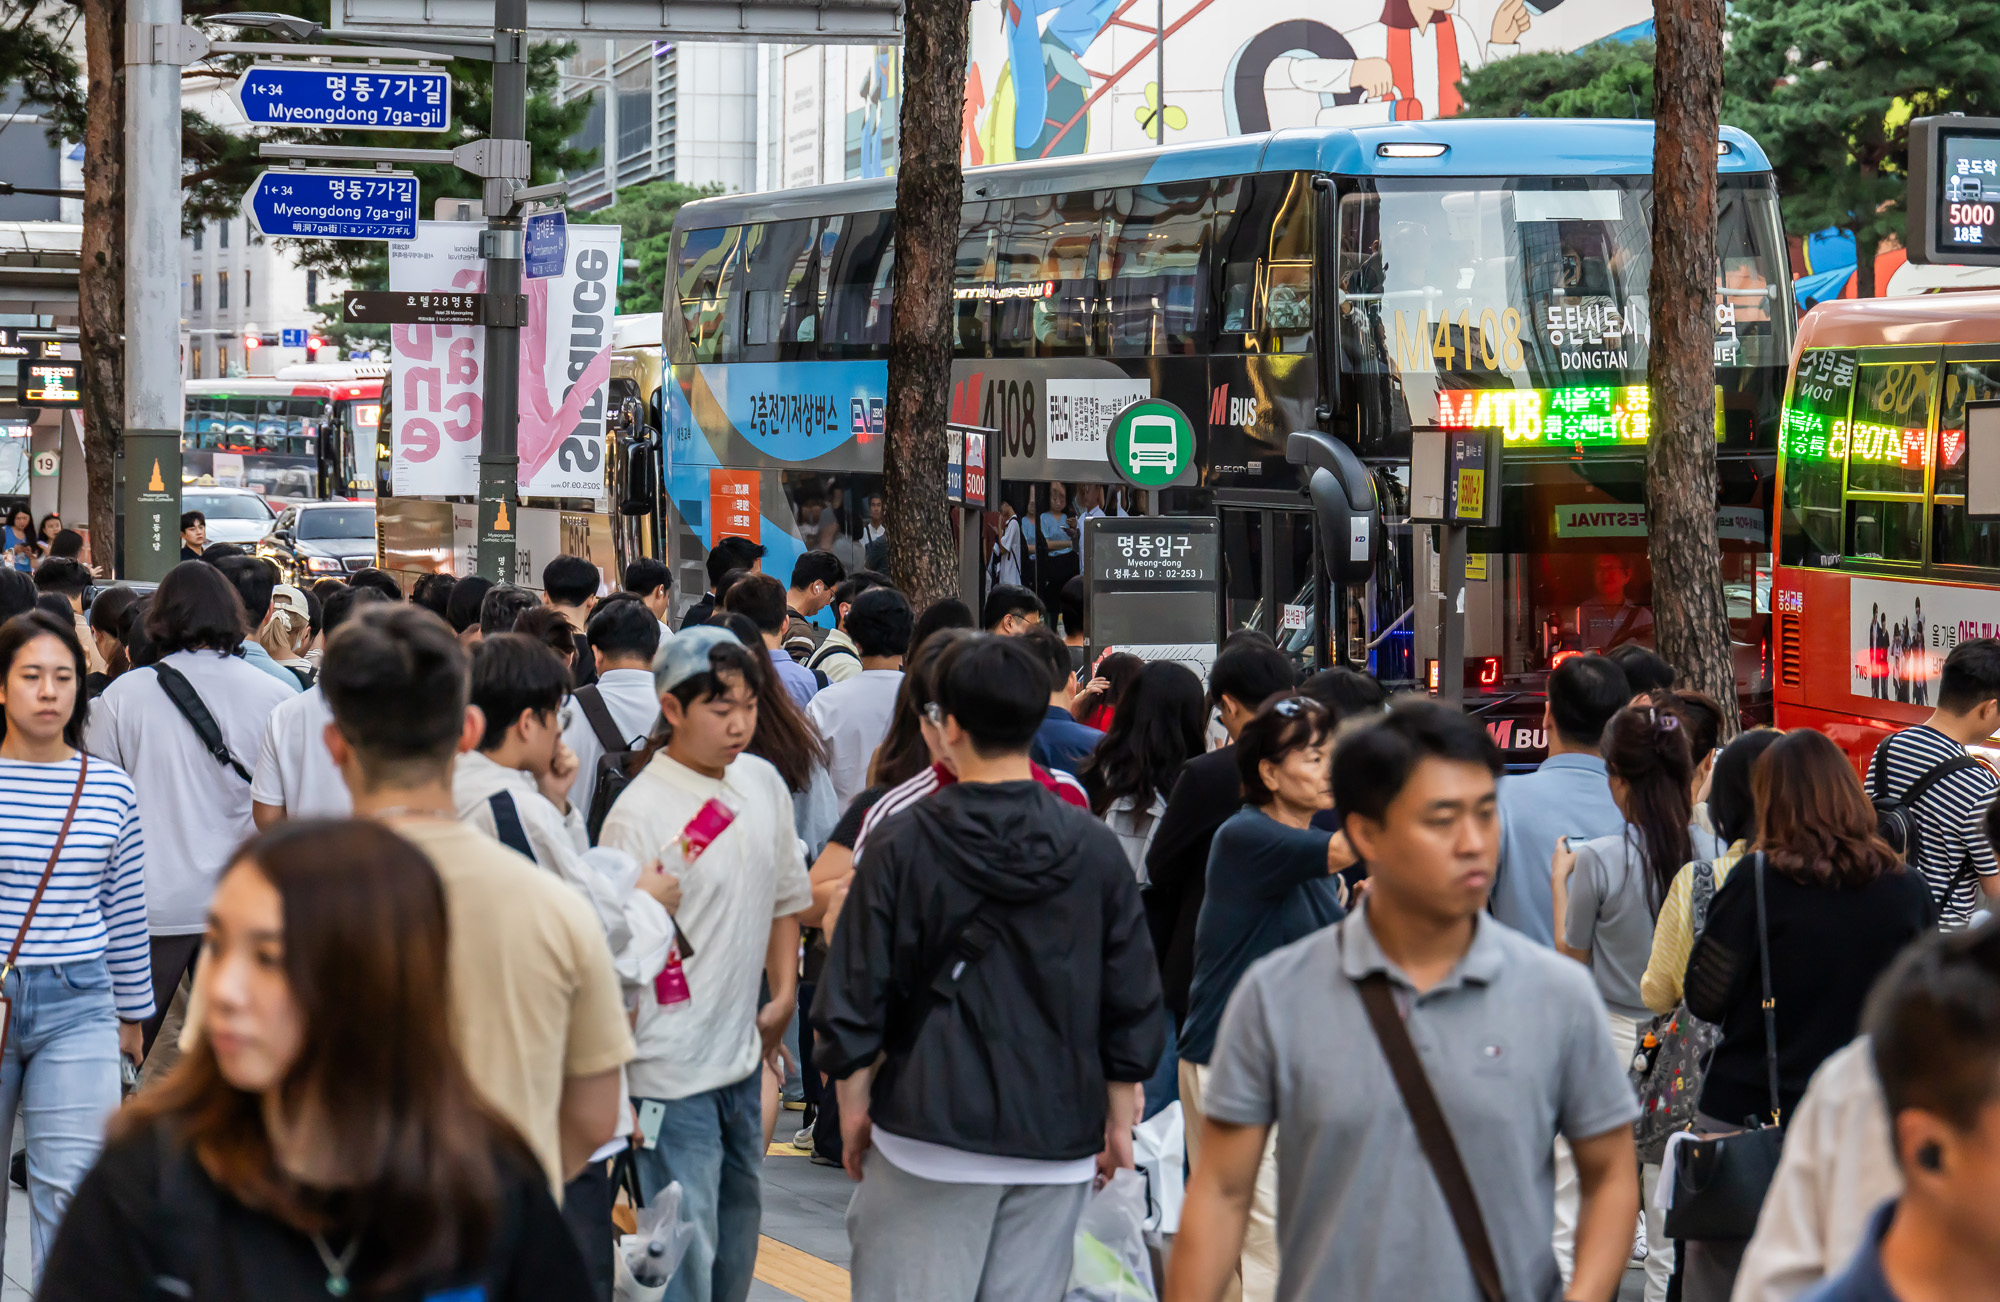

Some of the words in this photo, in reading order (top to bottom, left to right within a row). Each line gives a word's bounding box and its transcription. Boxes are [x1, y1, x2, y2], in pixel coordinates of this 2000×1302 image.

[268, 84, 283, 96] 34
[326, 75, 441, 105] 명동7가길
[268, 103, 378, 124] Myeongdong
[382, 107, 441, 126] 7ga-gil
[1956, 158, 1998, 176] 곧도착
[281, 186, 293, 196] 34
[328, 180, 412, 203] 명동7가길
[273, 202, 362, 219] Myeongdong
[365, 206, 412, 221] 7ga-gil
[1950, 204, 1995, 225] 5000
[1953, 226, 1983, 243] 18분
[1546, 303, 1639, 346] 동탄신도시
[1395, 306, 1525, 373] M4108
[1561, 350, 1628, 370] DONGTAN
[1551, 386, 1610, 413] 서울역
[750, 391, 838, 437] 2층전기저상버스
[1230, 396, 1257, 427] BUS
[1440, 388, 1541, 441] M4108
[37, 458, 53, 470] 19
[967, 473, 985, 496] 5000
[152, 513, 161, 551] 명동성당
[1117, 535, 1192, 558] 명동입구
[1113, 569, 1140, 578] 정류소
[1144, 569, 1155, 578] ID
[1165, 569, 1196, 578] 02-253
[1127, 558, 1182, 568] Myeong-dong
[1285, 609, 1305, 625] 입석금지
[1855, 665, 1868, 680] TWS
[1515, 729, 1548, 749] BU
